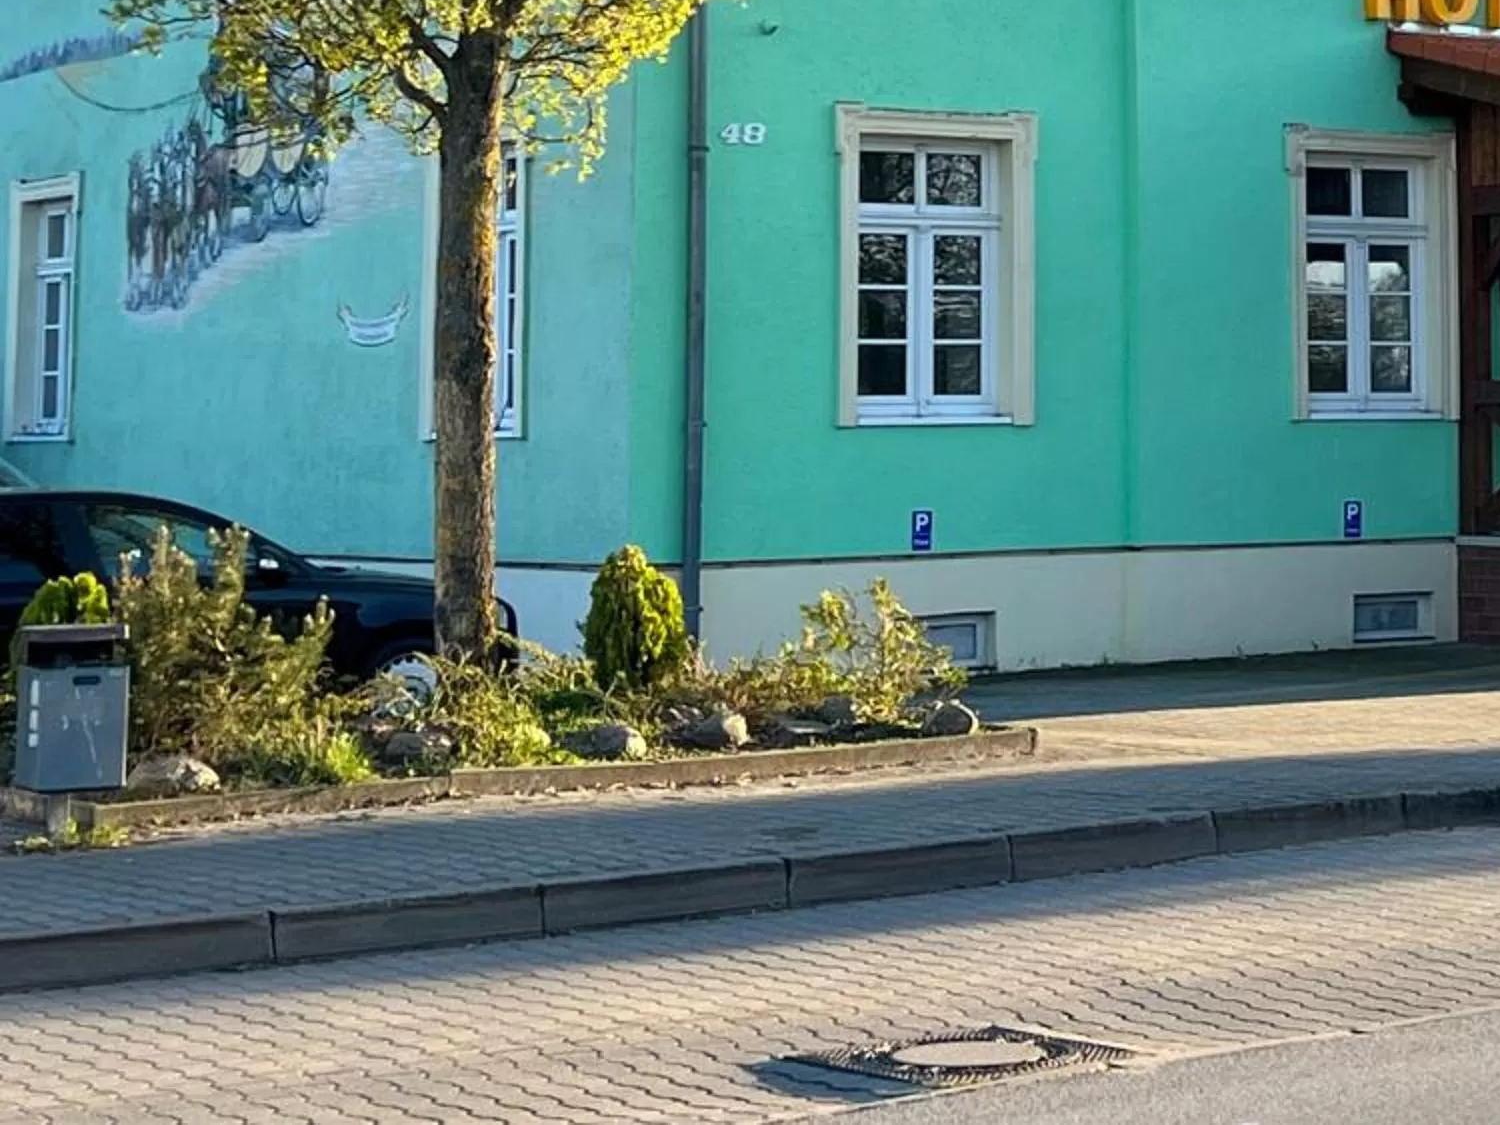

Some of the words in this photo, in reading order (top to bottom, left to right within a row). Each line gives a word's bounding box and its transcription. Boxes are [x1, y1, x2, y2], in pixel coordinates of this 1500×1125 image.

[720, 122, 767, 145] 48
[1347, 503, 1359, 520] P
[915, 513, 929, 532] P
